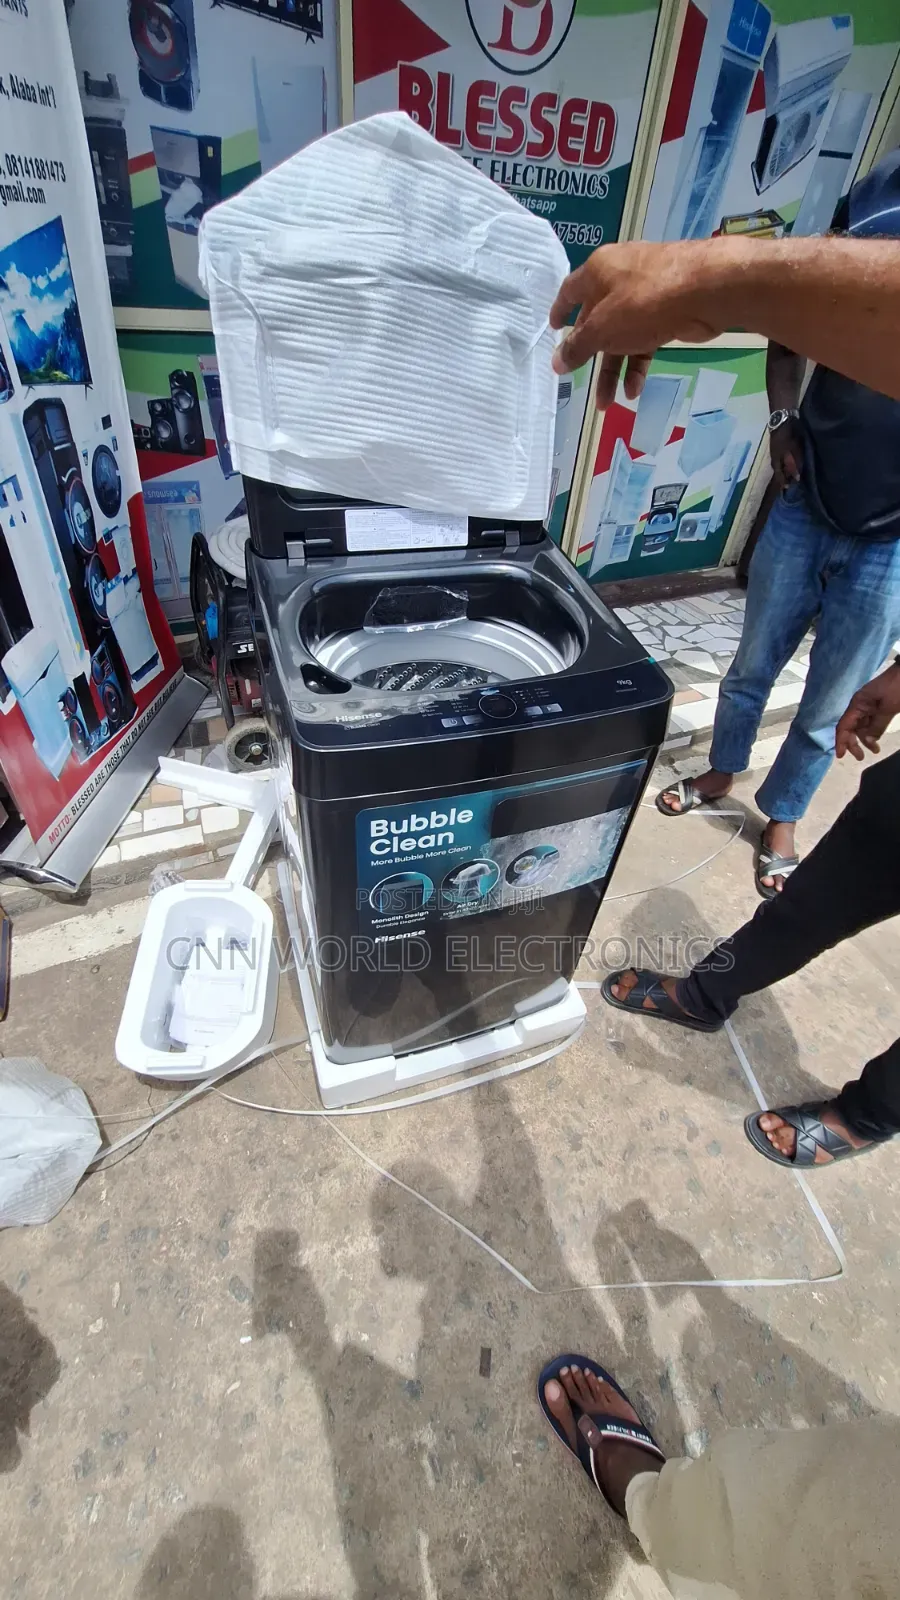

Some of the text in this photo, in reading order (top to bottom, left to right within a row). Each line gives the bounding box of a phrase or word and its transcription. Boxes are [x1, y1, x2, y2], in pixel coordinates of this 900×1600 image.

[9, 73, 38, 104] Alaba
[398, 61, 617, 169] BLESSED
[5, 153, 66, 182] 08141881473
[489, 159, 610, 199] ELECTRONICS
[510, 193, 557, 214] hatsapp
[335, 712, 382, 723] Hisense
[48, 813, 72, 844] MOTTO:
[71, 783, 95, 816] BLESSED
[94, 770, 106, 788] ARE
[104, 751, 121, 773] THOSE
[119, 735, 131, 755] THAT
[370, 808, 474, 837] Bubble
[370, 831, 455, 855] Clean
[371, 845, 472, 867] More Bubble More Clean
[404, 910, 429, 919] Design
[374, 929, 426, 944] Hisense
